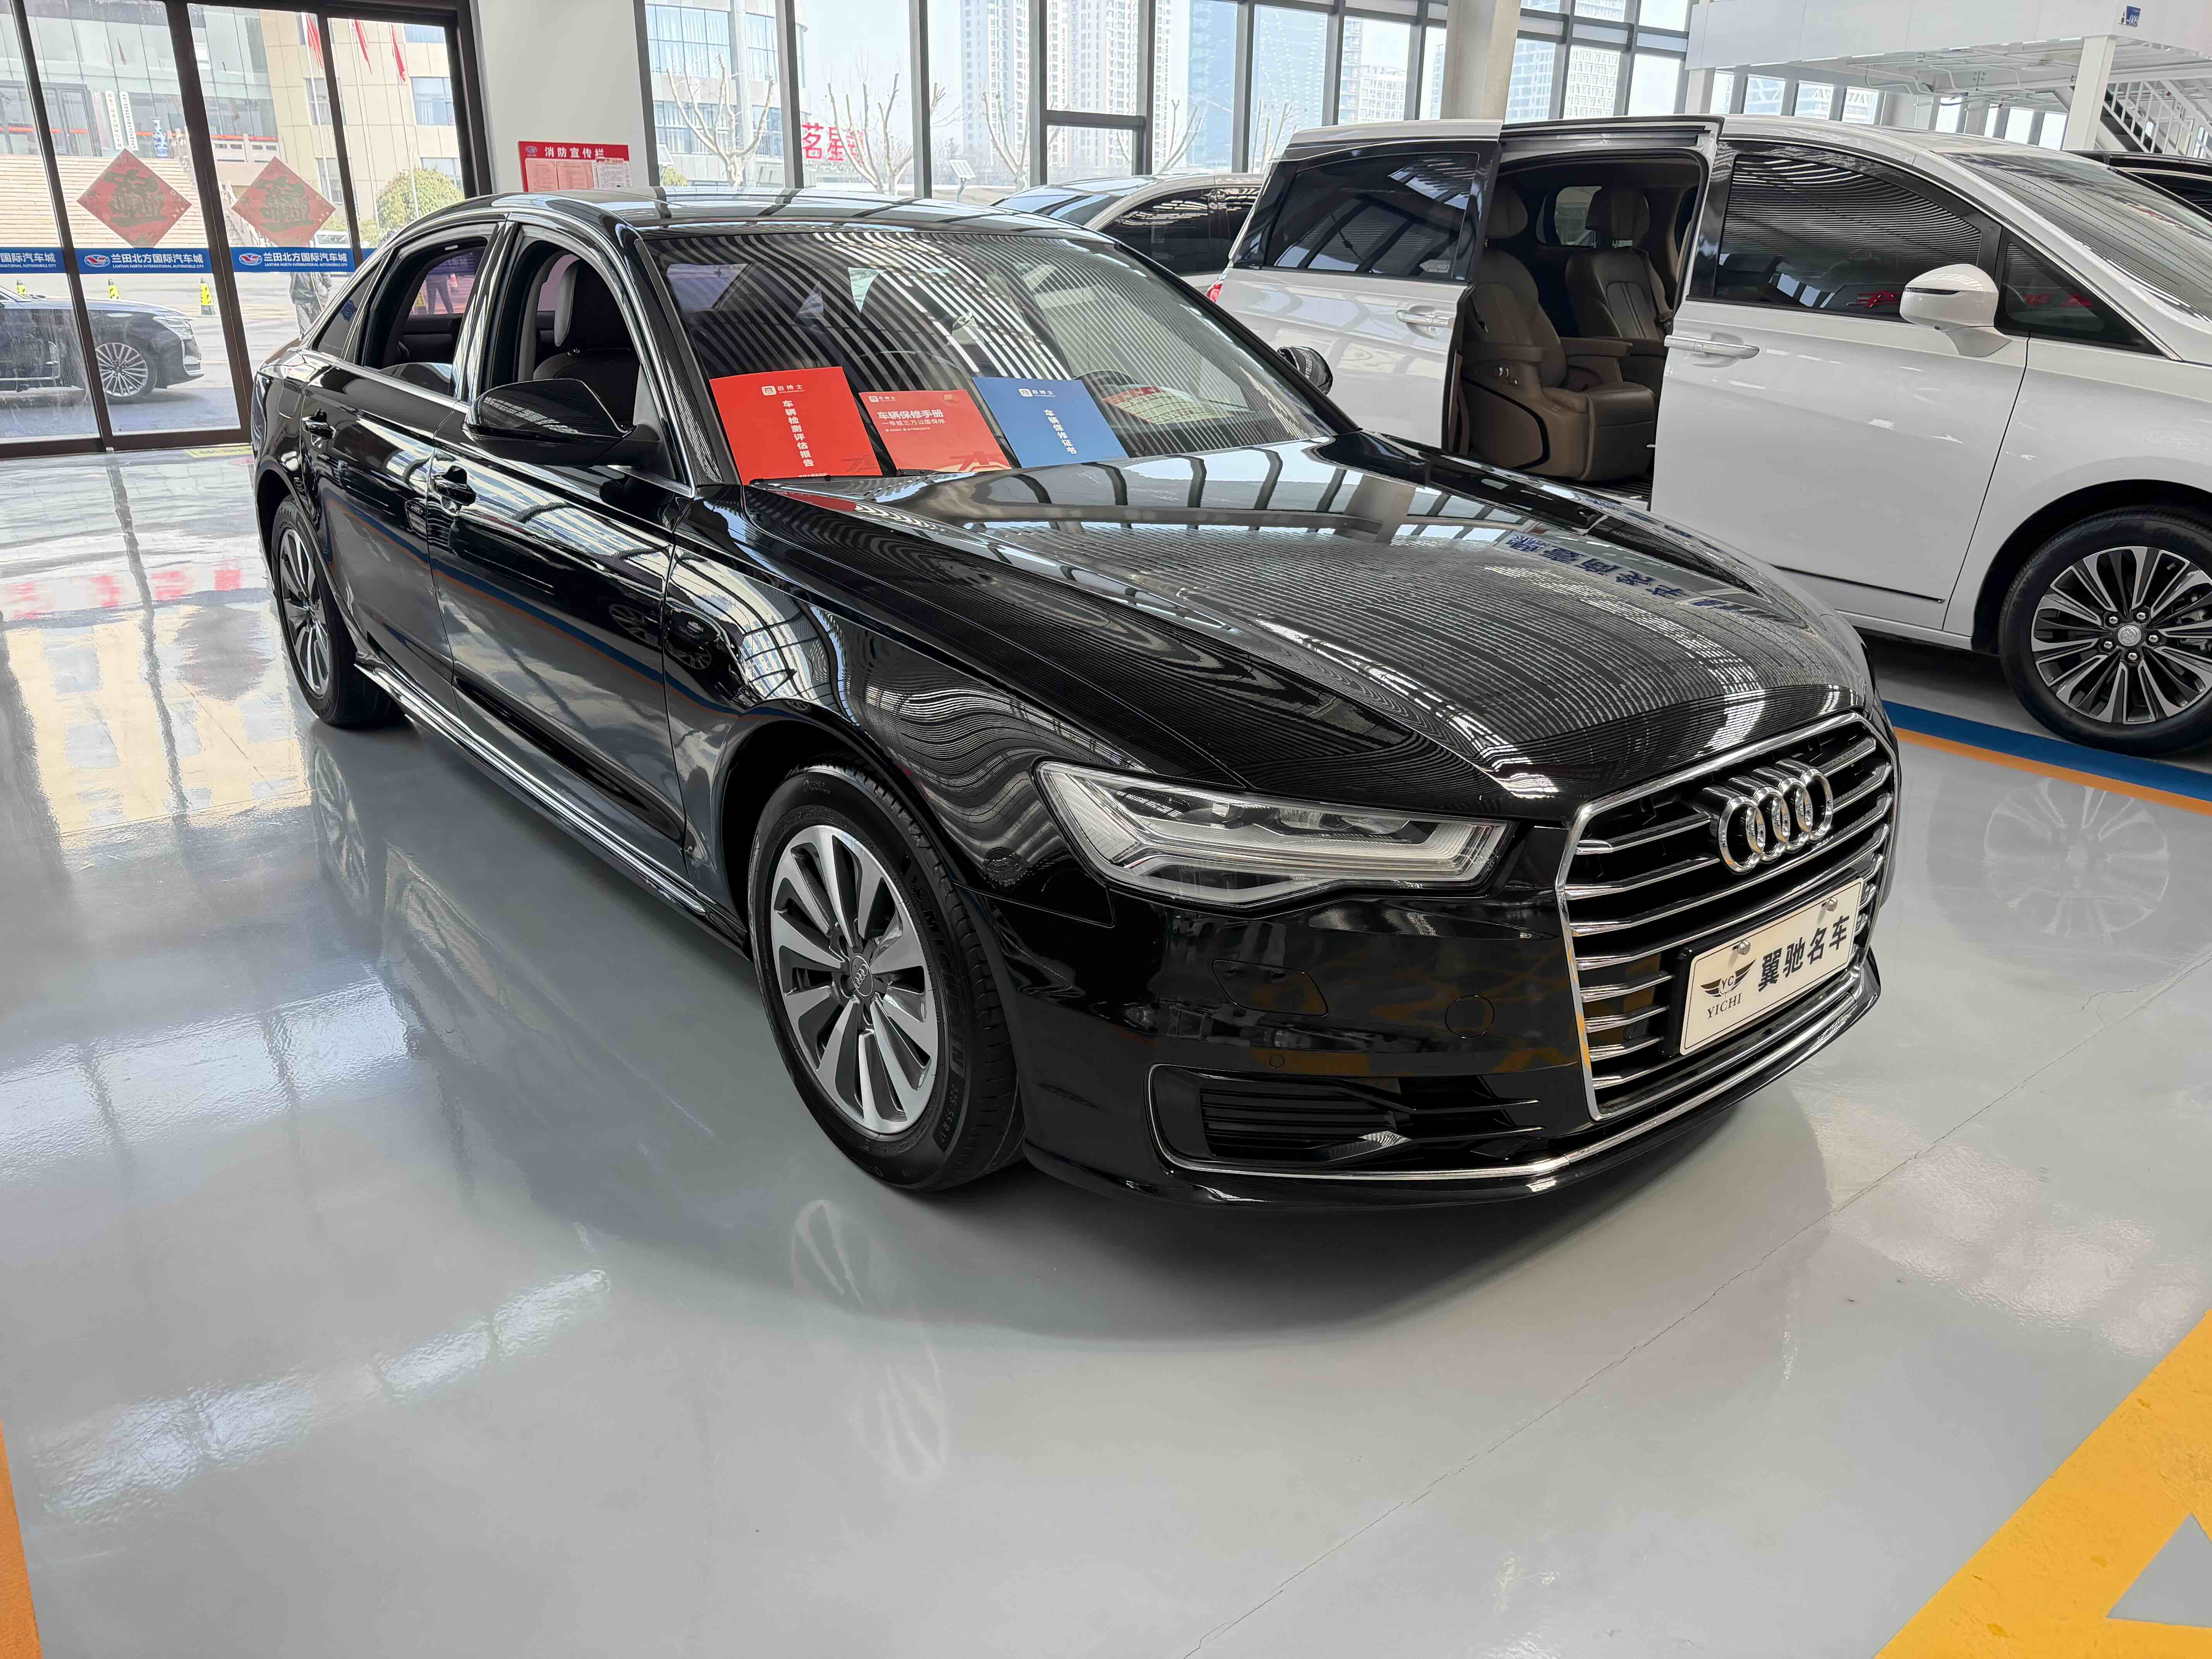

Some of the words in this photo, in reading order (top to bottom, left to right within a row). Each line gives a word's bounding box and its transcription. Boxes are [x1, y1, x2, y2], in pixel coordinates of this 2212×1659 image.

[544, 146, 605, 159] 消防宣传栏
[111, 254, 203, 263] 兰田北方国际汽车城
[263, 252, 347, 262] 兰田北方国际汽车城
[877, 409, 944, 420] 车辆保修手册
[782, 400, 815, 467] 车辆检测评估报告
[1044, 409, 1077, 454] 车辆保修证书
[1758, 915, 1850, 993] 翼驰名车
[1721, 975, 1735, 990] YC
[1707, 993, 1742, 1019] YICHI
